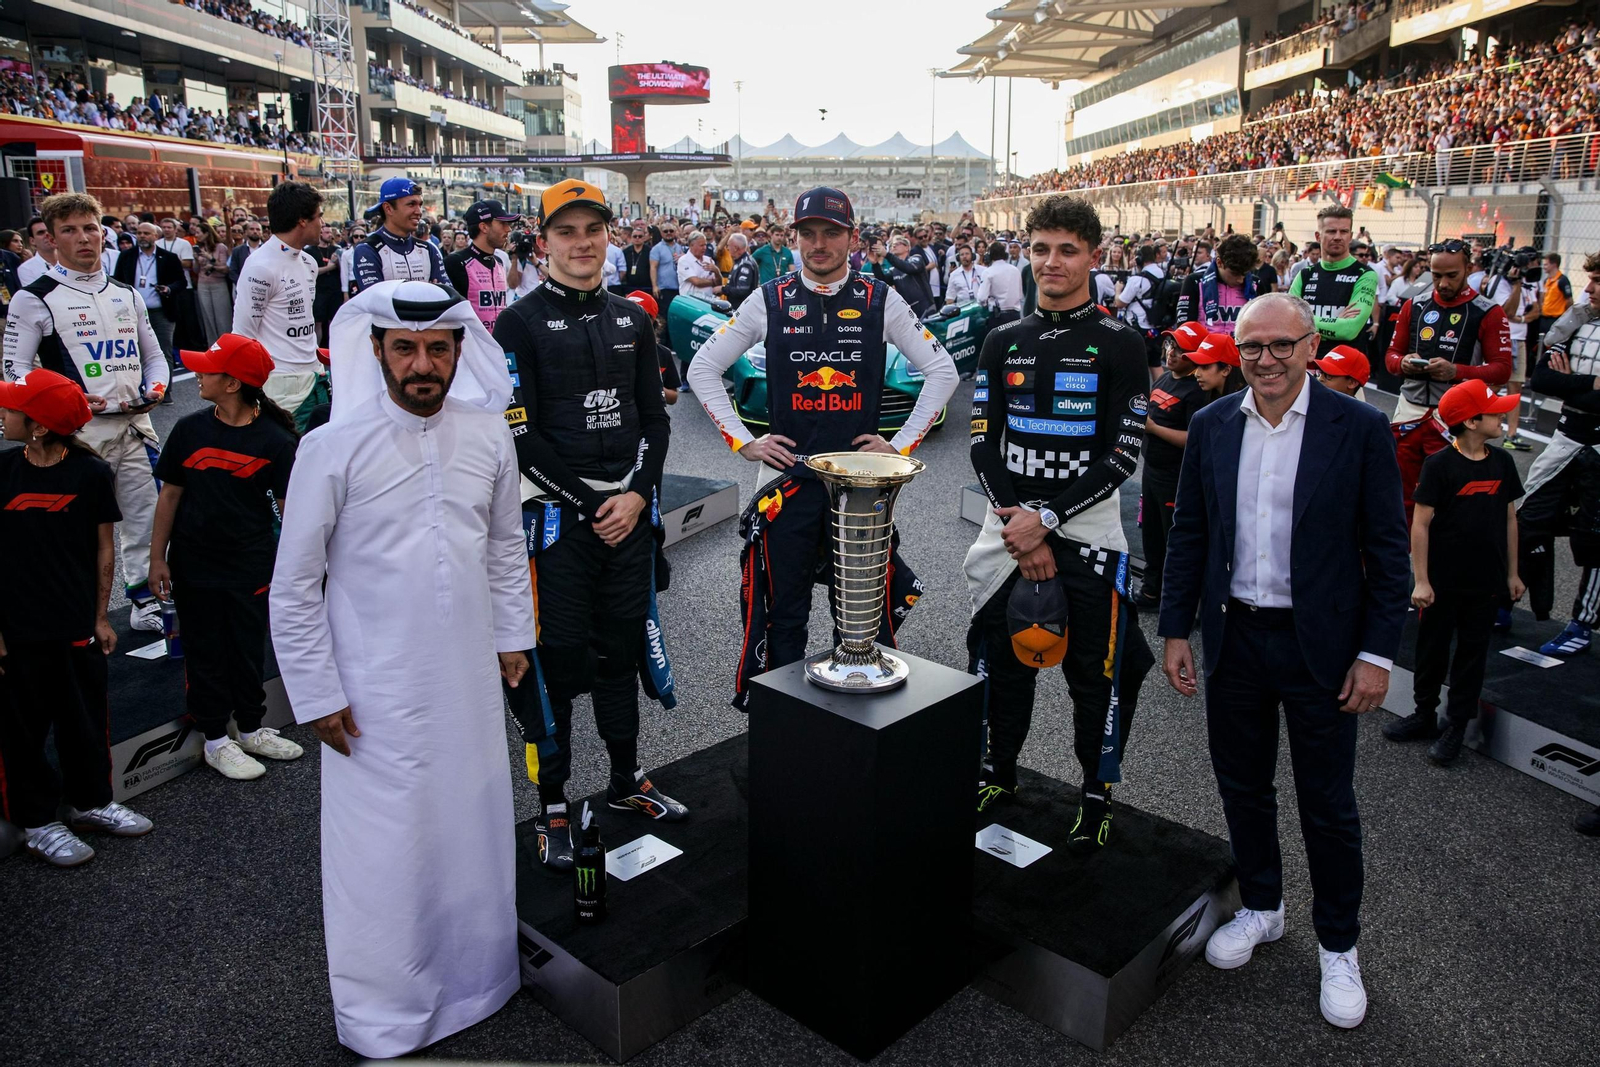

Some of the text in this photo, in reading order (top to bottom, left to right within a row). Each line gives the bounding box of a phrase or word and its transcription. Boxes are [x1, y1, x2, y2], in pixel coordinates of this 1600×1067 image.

[637, 72, 686, 80] THE ULTIMATE
[639, 80, 685, 88] SHOWDOWN
[802, 196, 810, 210] 1
[54, 262, 68, 277] VISA
[1335, 274, 1359, 283] KICK
[290, 298, 304, 306] BOSS
[1214, 306, 1242, 322] BW
[1426, 313, 1438, 322] hp
[72, 320, 97, 328] TUDOR
[783, 326, 805, 334] Mobil
[76, 330, 98, 338] Mobil
[286, 323, 314, 338] aram
[1319, 328, 1336, 338] KICK
[80, 340, 138, 361] VISA
[790, 351, 862, 362] ORACLE
[951, 345, 976, 361] ramco
[1005, 357, 1036, 365] Android
[792, 393, 862, 411] Red Bull
[1058, 399, 1092, 412] allwyn
[504, 411, 523, 422] ALT
[1008, 417, 1092, 435] DELL Technologies
[1131, 420, 1146, 430] Dropb
[635, 437, 649, 472] allwyn
[1006, 442, 1090, 479] OKX
[529, 466, 584, 507] RICHARD MILLE
[980, 472, 996, 502] RICHARD
[1065, 482, 1114, 516] RICHARD MILLE
[645, 619, 666, 669] allwyn
[1033, 652, 1045, 664] 4
[152, 762, 174, 772] Formula
[1531, 758, 1546, 771] FIA
[124, 775, 140, 788] FIA
[143, 771, 160, 781] World
[1548, 770, 1563, 781] World
[1557, 770, 1580, 782] Formula
